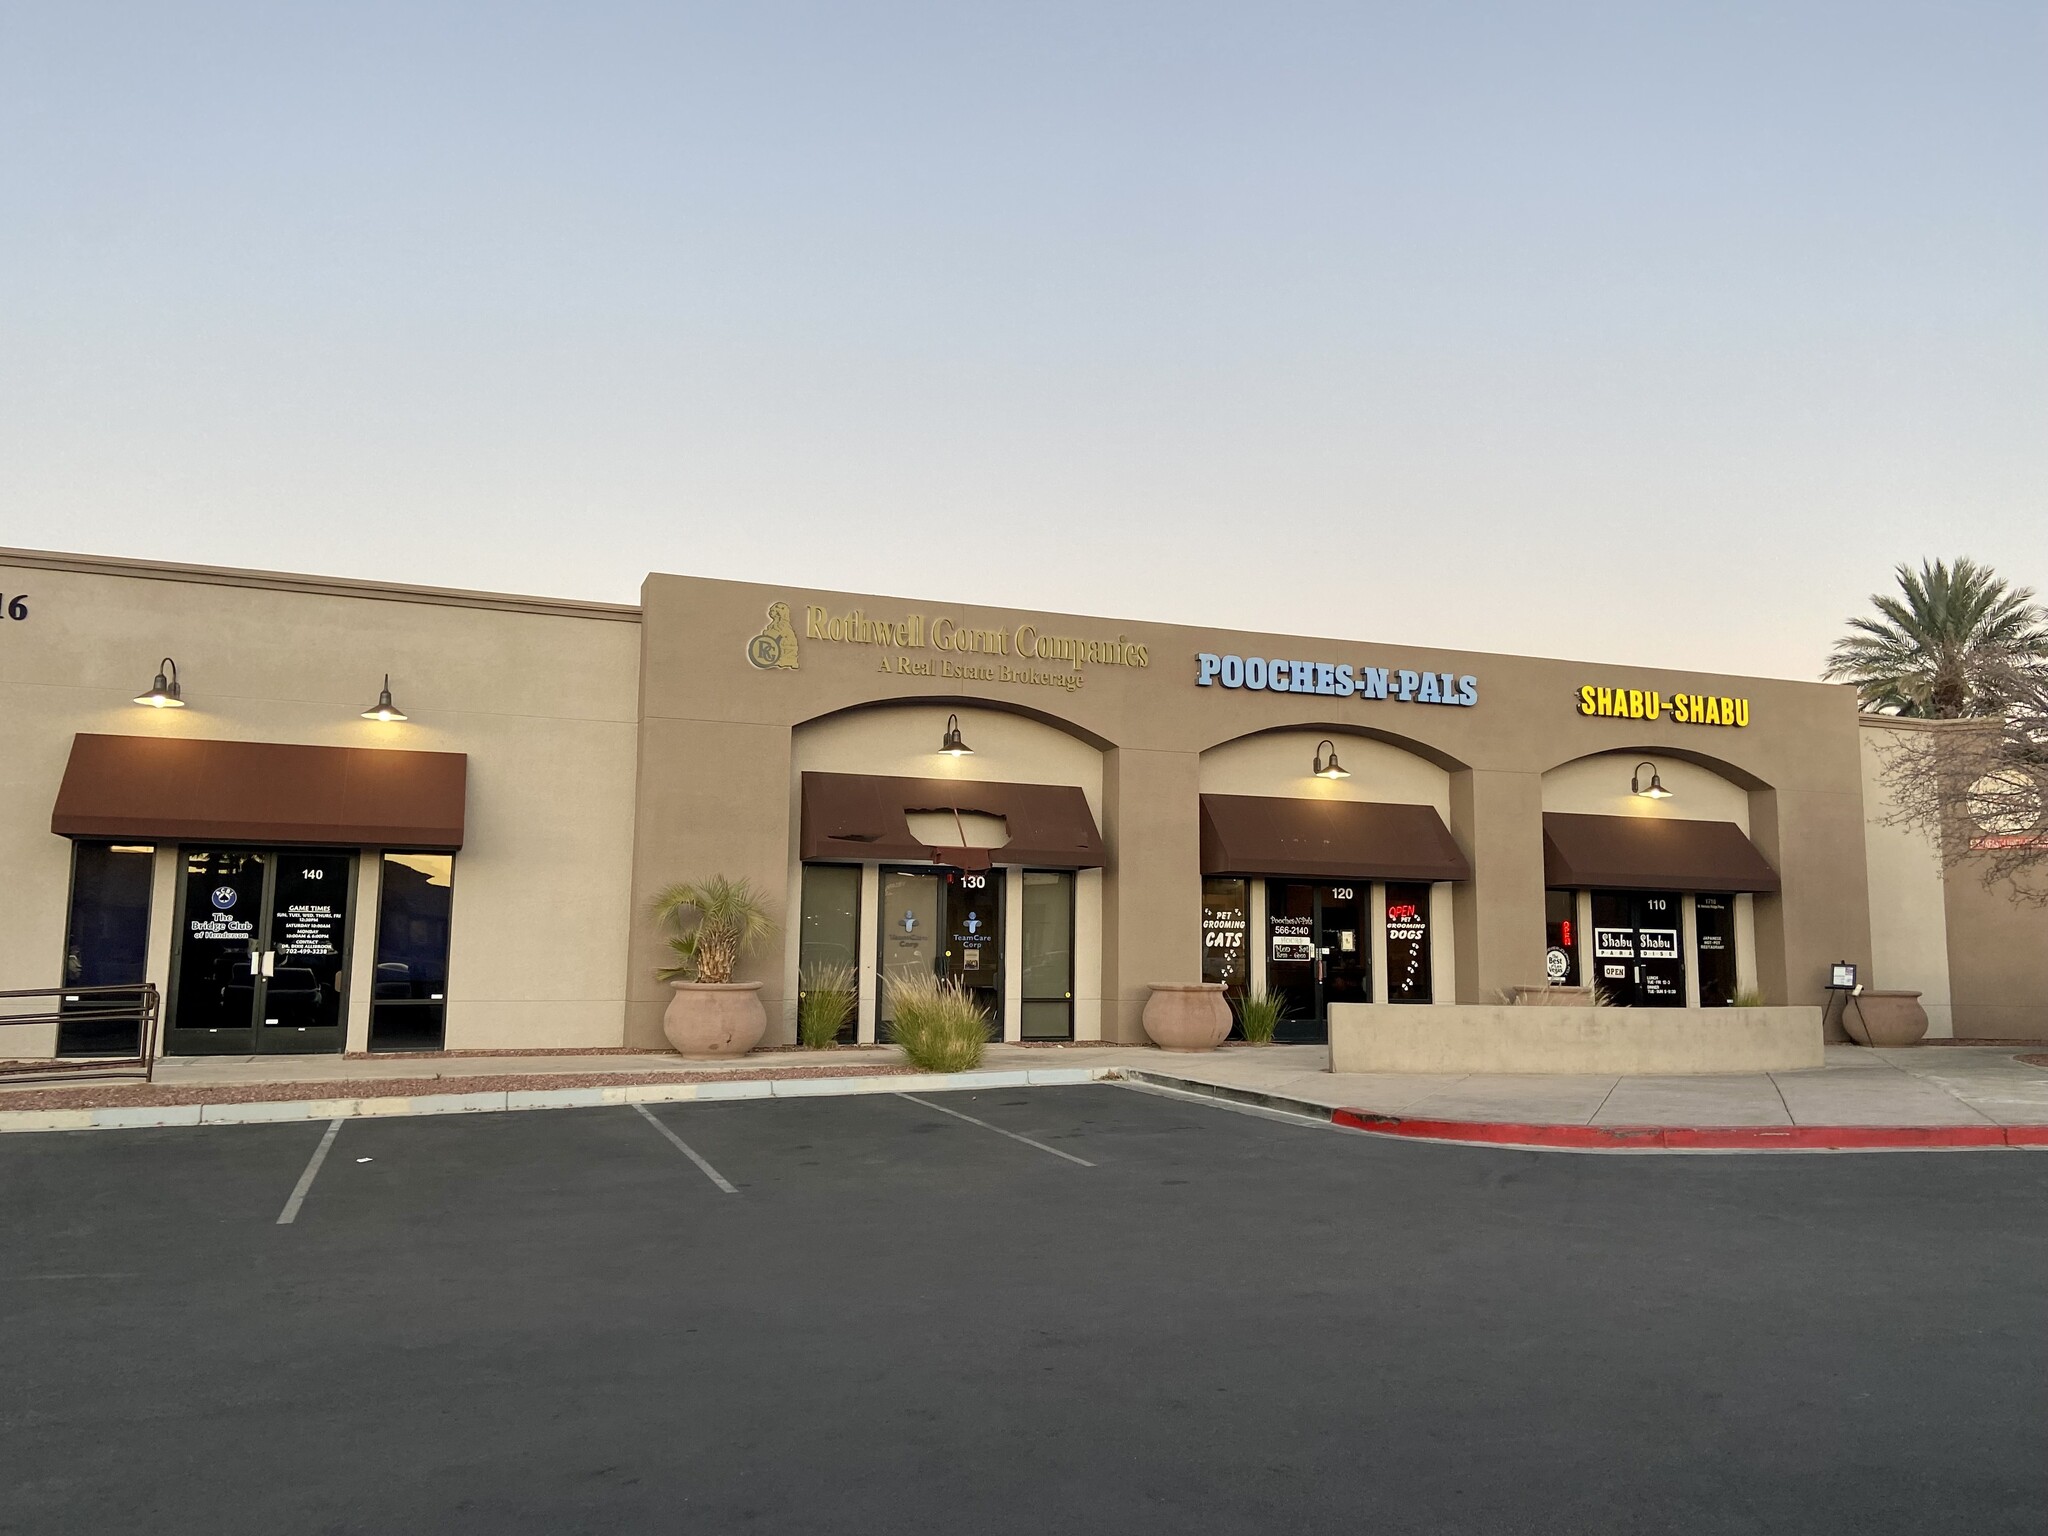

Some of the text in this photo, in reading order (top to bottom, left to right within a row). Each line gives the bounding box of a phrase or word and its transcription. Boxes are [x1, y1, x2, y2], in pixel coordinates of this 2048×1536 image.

[806, 604, 1149, 671] Rothwell Gornt Companies
[878, 656, 1084, 692] A Real Estate Brokerage
[1196, 652, 1478, 707] POOCHES-N-PALS
[1577, 685, 1749, 728] SHABU-SHABU
[302, 869, 324, 880] 140
[960, 876, 986, 889] 130
[1332, 887, 1354, 899] 120
[1647, 899, 1667, 910] 110
[1216, 911, 1232, 920] PET
[1388, 904, 1415, 918] OPEN
[212, 912, 233, 922] The
[191, 921, 253, 932] Bridge Club
[1203, 920, 1246, 929] GROOMING
[1274, 925, 1309, 935] 566-2140
[193, 931, 249, 939] of Henderson
[953, 934, 992, 942] TeamCare
[1205, 931, 1243, 948] CATS
[1390, 930, 1424, 940] DOGS
[963, 941, 982, 949] Corp
[1601, 933, 1671, 949] Shabu Shabu
[1549, 956, 1563, 965] Best
[1606, 967, 1624, 976] OPEN
